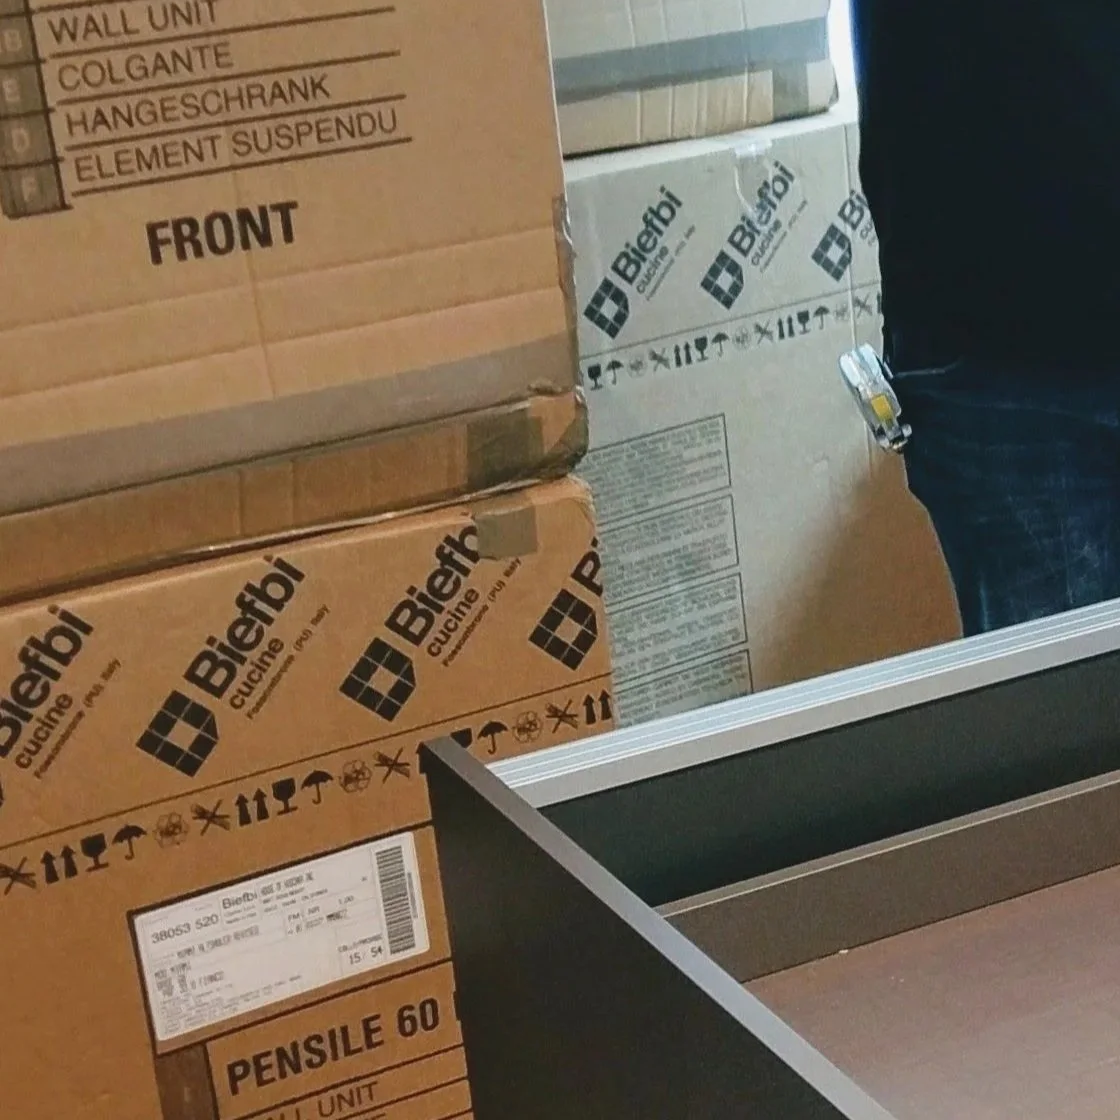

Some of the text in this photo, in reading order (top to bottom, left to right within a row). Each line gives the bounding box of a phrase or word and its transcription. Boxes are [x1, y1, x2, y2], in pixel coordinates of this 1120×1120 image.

[47, 7, 140, 46] WALL
[57, 43, 234, 92] COLGANTE
[67, 74, 331, 137] HANGESCHRANK
[74, 109, 398, 182] ELEMENT SUSPENDU
[146, 201, 299, 266] FRONT
[611, 185, 683, 285] Biefbi
[727, 160, 796, 258] Biefbi
[751, 218, 783, 267] cucine
[636, 245, 670, 295] cucine
[183, 554, 306, 699] Biefbi
[426, 587, 480, 658] cucine
[229, 637, 285, 710] cucine
[15, 693, 73, 769] cucine
[222, 890, 258, 909] Biefbi
[226, 997, 440, 1096] PENSILE 60
[317, 1081, 379, 1118] UNIT
